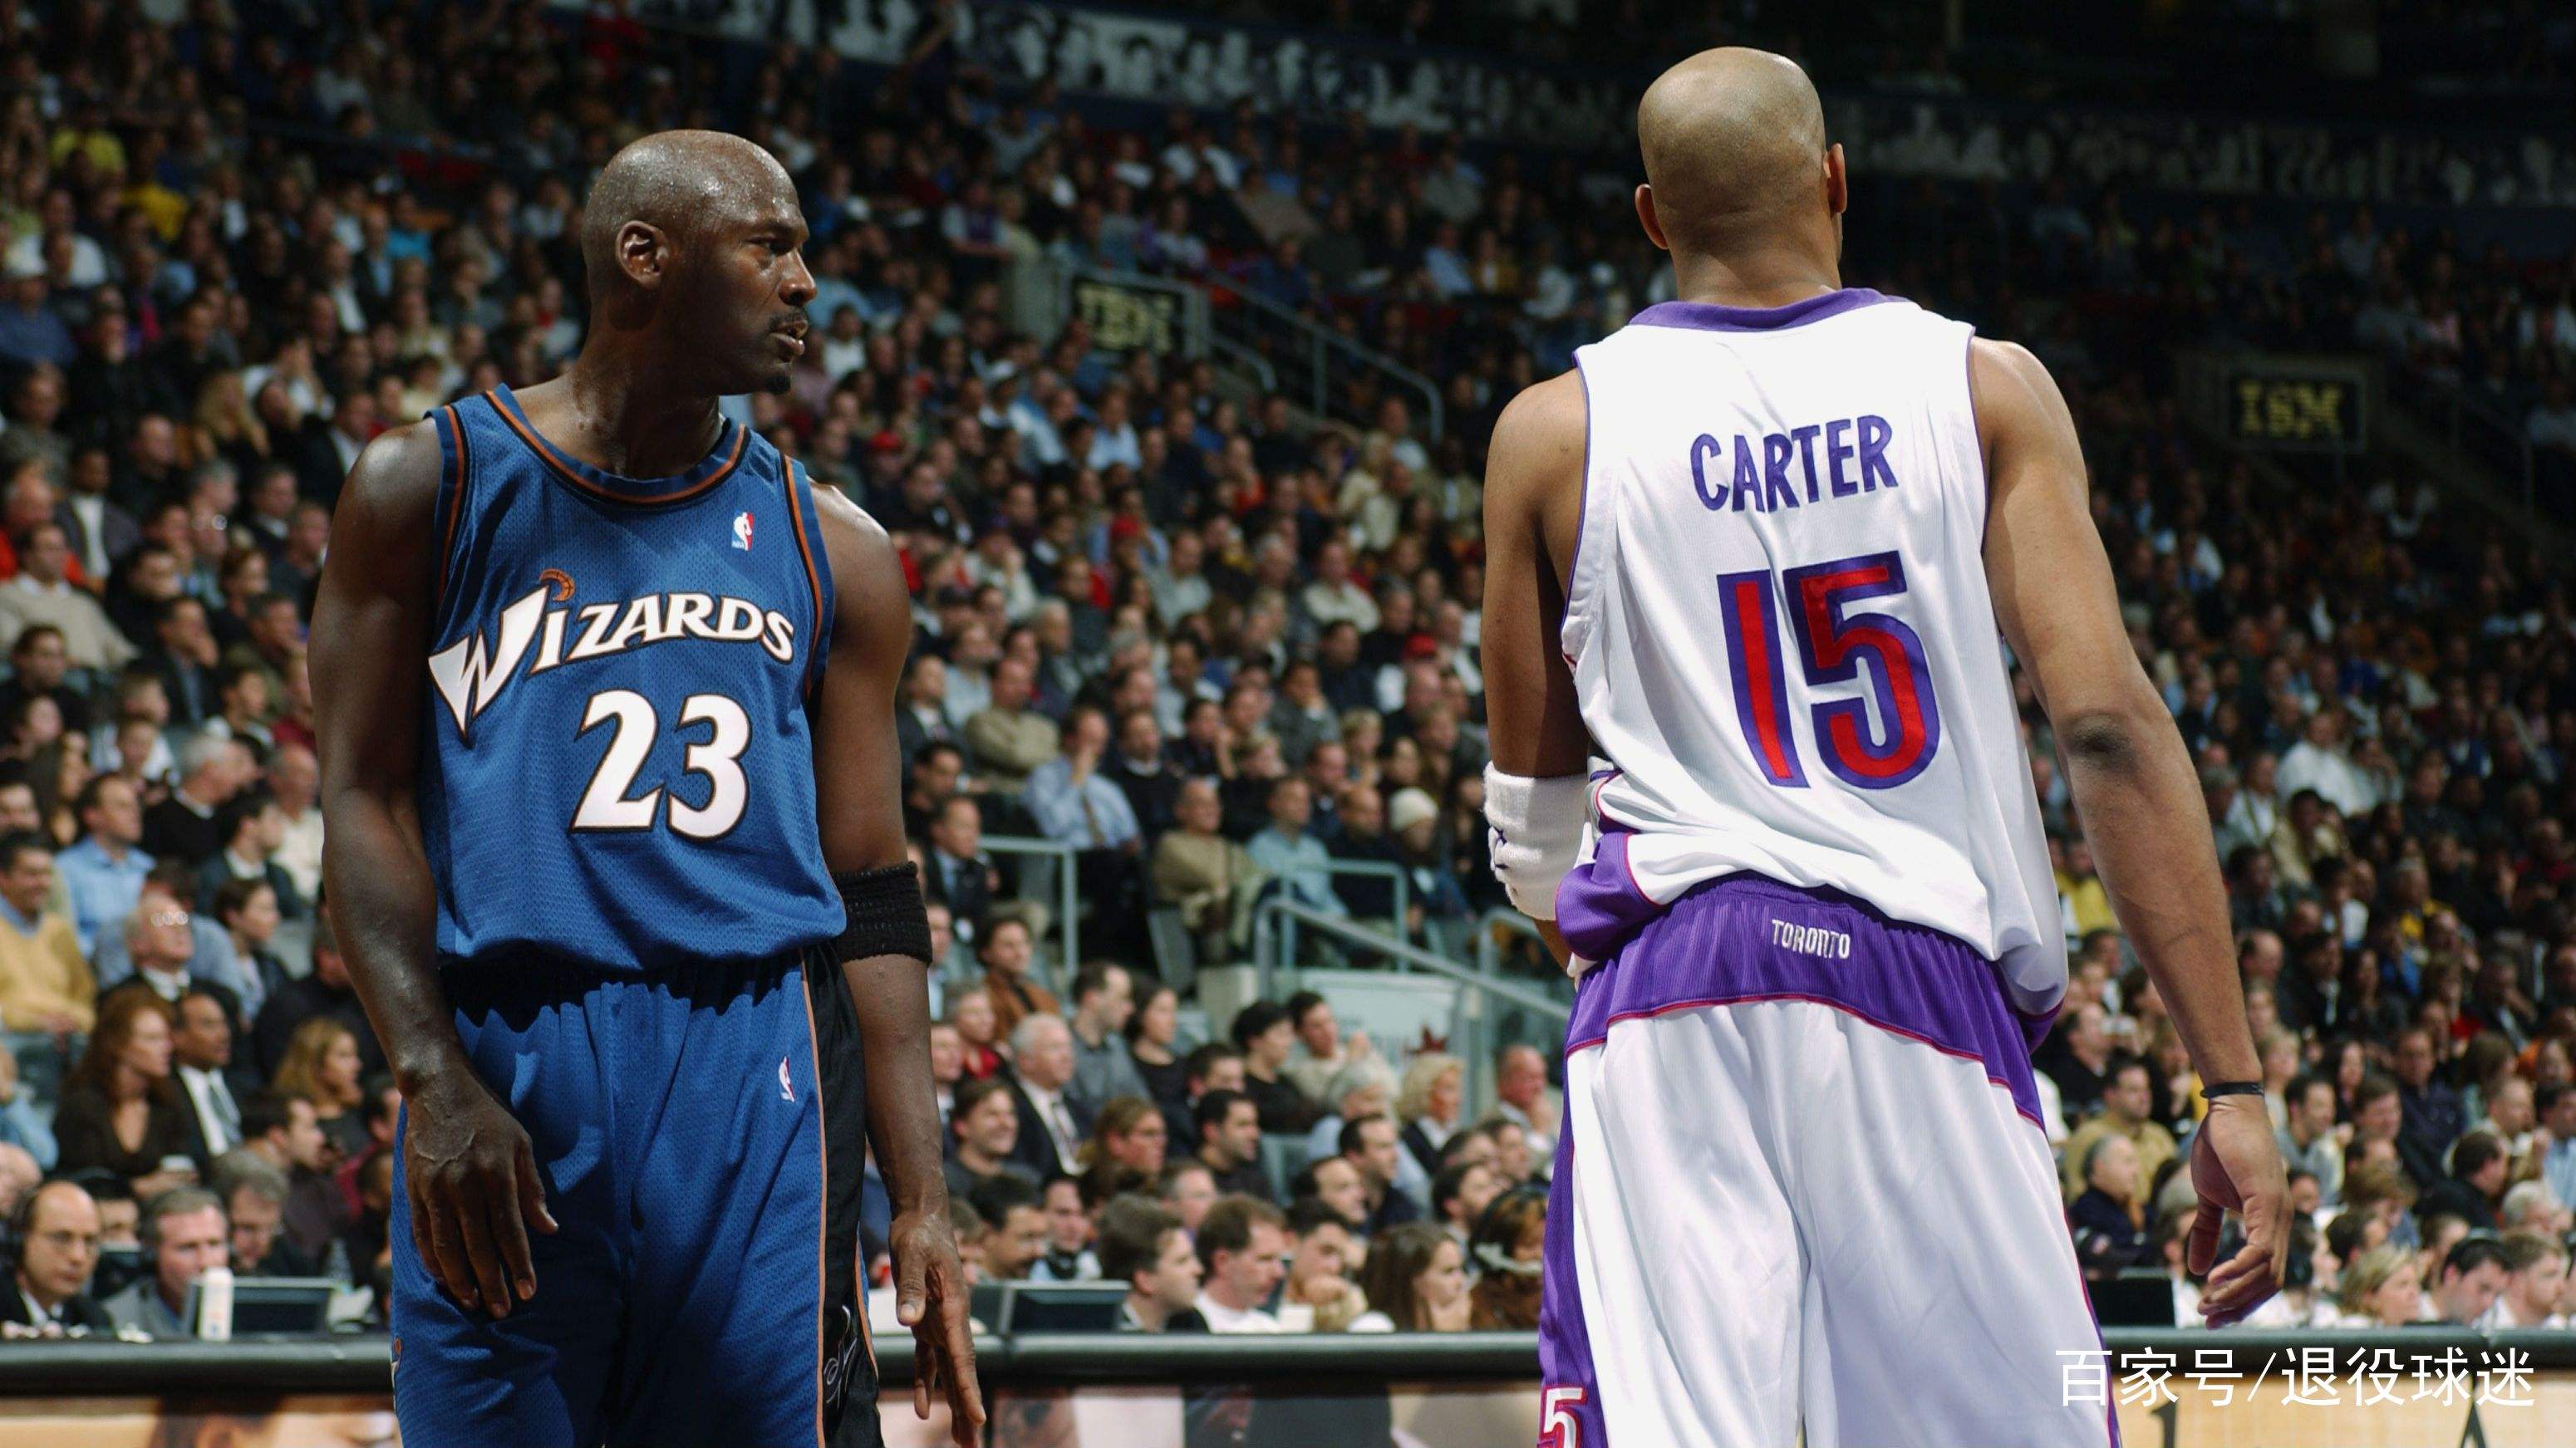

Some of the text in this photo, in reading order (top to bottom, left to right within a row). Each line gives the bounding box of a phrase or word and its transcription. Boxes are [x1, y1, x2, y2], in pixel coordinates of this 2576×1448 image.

[1689, 414, 1899, 513] CARTER
[427, 575, 795, 748] WIZARDS
[1716, 549, 1940, 790] 15
[567, 689, 753, 844] 23
[1771, 918, 1851, 960] TORONTO
